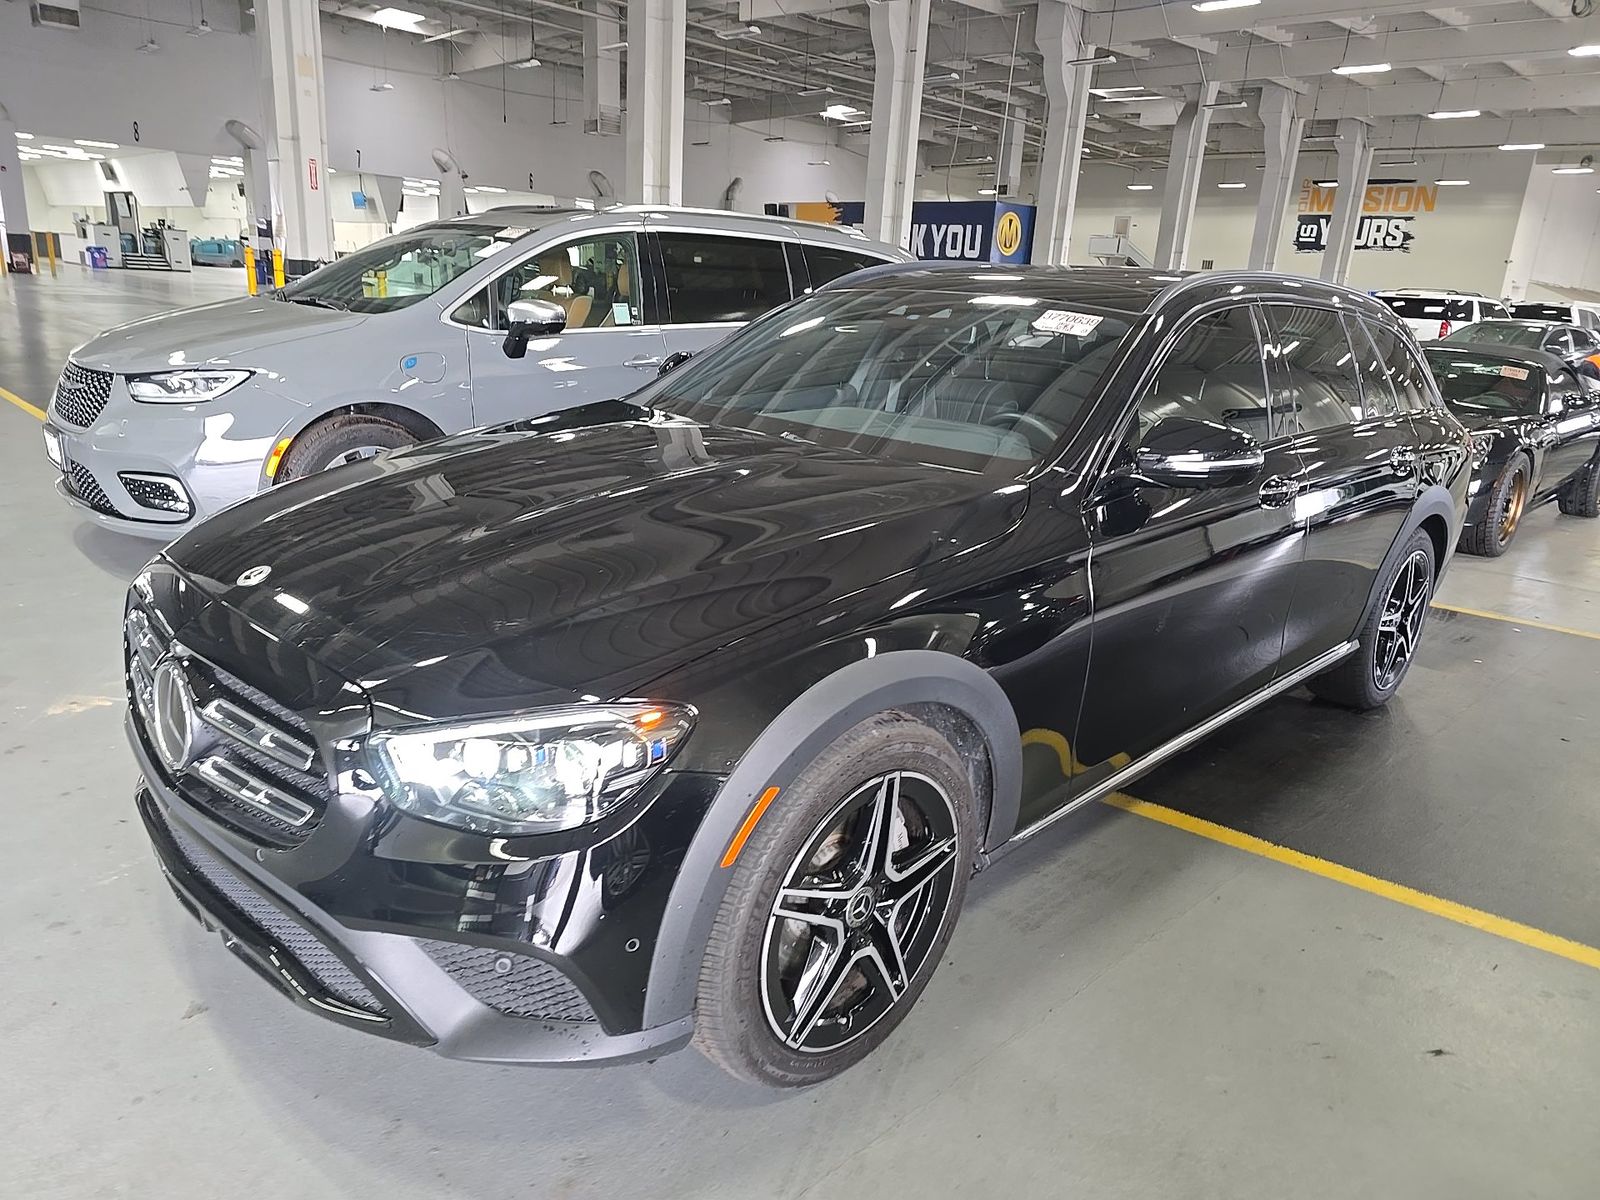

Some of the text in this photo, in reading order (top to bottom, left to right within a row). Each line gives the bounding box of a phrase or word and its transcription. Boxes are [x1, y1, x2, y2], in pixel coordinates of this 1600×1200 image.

[133, 120, 140, 142] 8
[1309, 185, 1438, 212] MSION
[931, 223, 983, 258] YOU
[1299, 217, 1408, 248] IS YURS
